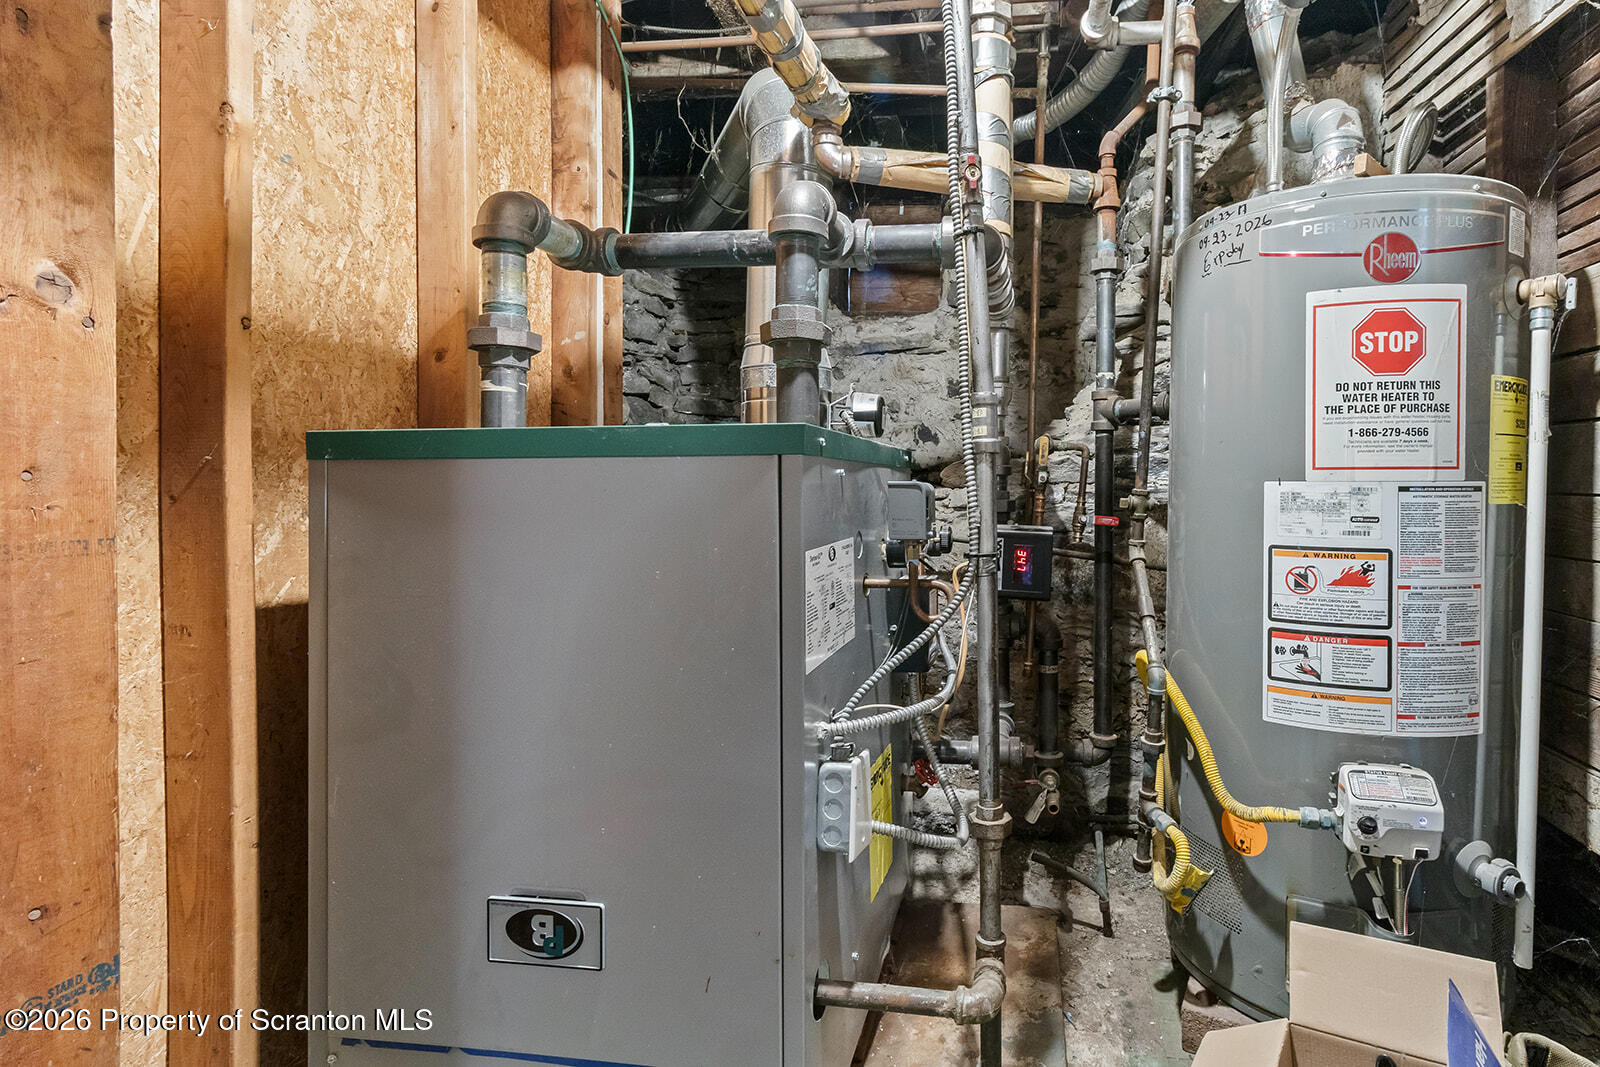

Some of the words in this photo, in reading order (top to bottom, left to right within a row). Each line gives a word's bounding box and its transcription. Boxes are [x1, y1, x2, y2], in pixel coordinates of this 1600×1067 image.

[1302, 215, 1429, 236] PERORMANCE
[1440, 215, 1473, 229] PLUS
[1369, 233, 1417, 276] Rheem
[1360, 331, 1419, 354] STOP
[1335, 383, 1349, 392] DO
[1353, 382, 1373, 391] NOT
[1377, 381, 1416, 390] RETURN
[1420, 380, 1441, 390] THIS
[1342, 393, 1378, 403] WATER
[1381, 392, 1419, 402] HEATER
[1423, 392, 1434, 401] TO
[1324, 405, 1344, 415] THE
[1347, 404, 1380, 414] PLACE
[1384, 404, 1397, 413] OF
[1400, 403, 1450, 413] PURCHASE
[1348, 427, 1429, 437] 1-866-279-4566
[1313, 552, 1356, 560] WARNING
[1313, 635, 1348, 644] DANGER
